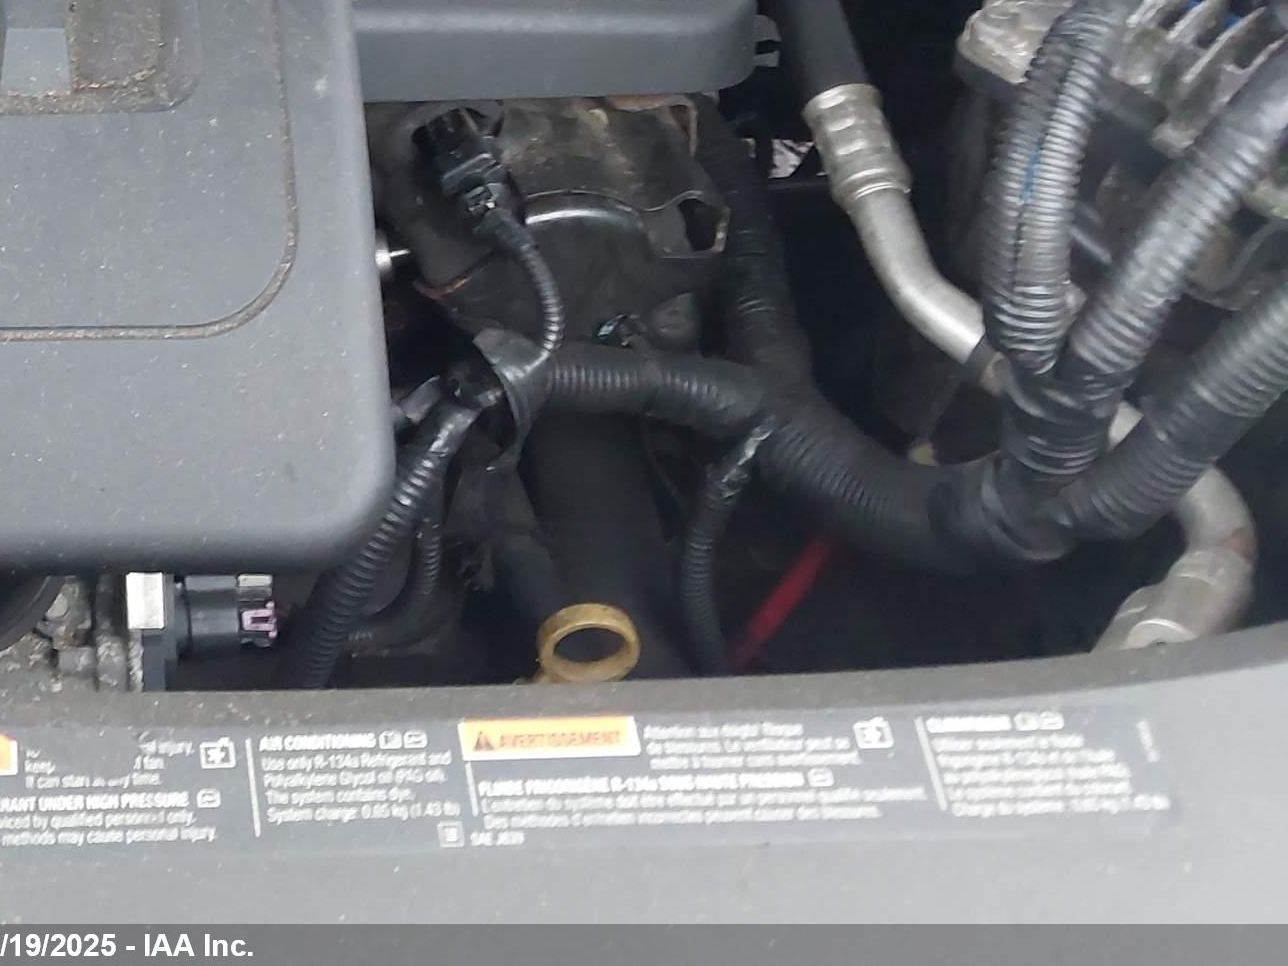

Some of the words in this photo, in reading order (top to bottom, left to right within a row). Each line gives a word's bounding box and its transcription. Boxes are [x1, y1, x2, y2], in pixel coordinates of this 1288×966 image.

[37, 777, 60, 788] can
[38, 794, 84, 811] UNDER
[86, 793, 119, 809] HIGH
[120, 791, 190, 809] PRESSURE
[32, 814, 49, 831] by
[50, 812, 103, 829] qualified
[2, 831, 56, 846] methods
[58, 831, 84, 847] may
[86, 830, 124, 844] cause
[126, 827, 179, 845] personal
